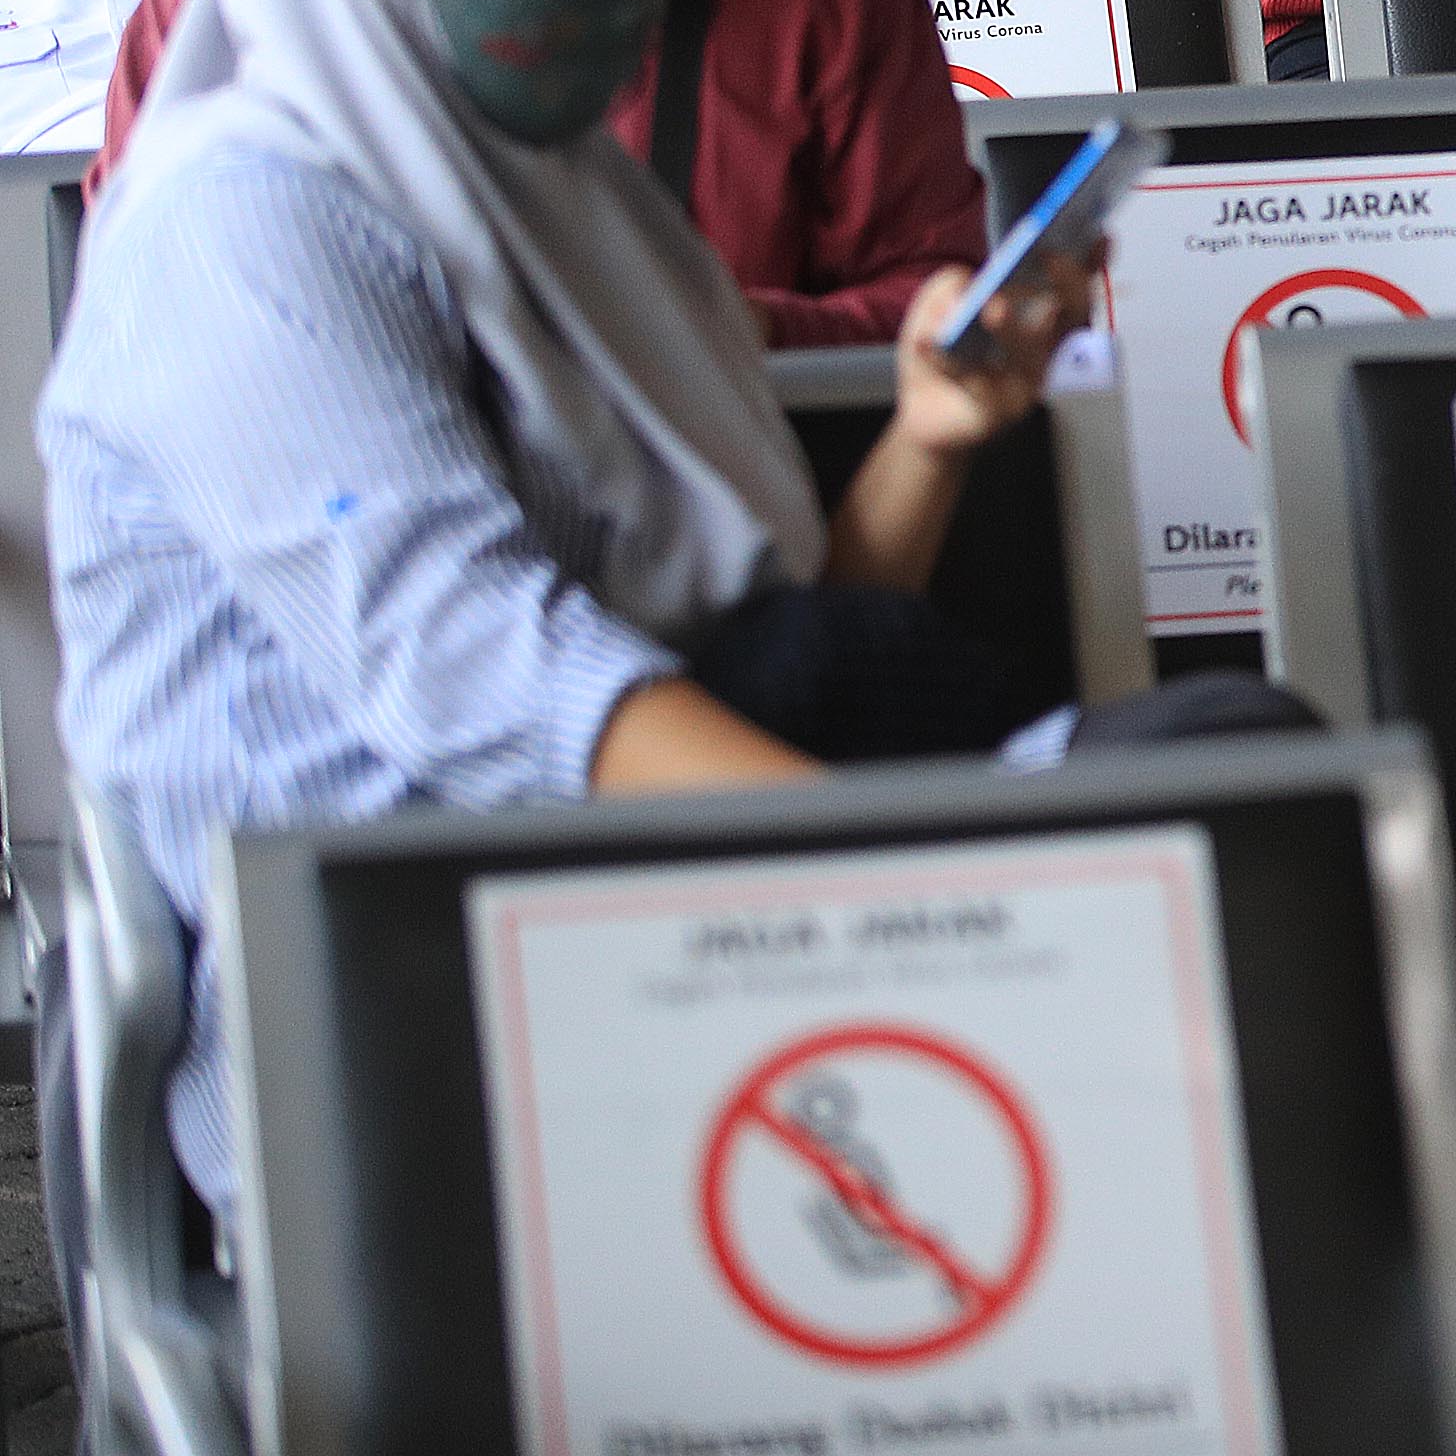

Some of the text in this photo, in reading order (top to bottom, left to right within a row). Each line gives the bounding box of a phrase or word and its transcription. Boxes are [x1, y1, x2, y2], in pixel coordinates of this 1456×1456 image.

[939, 24, 1043, 42] Virus Corona
[1214, 189, 1432, 226] JAGA JARAK
[1164, 522, 1256, 553] Dilar
